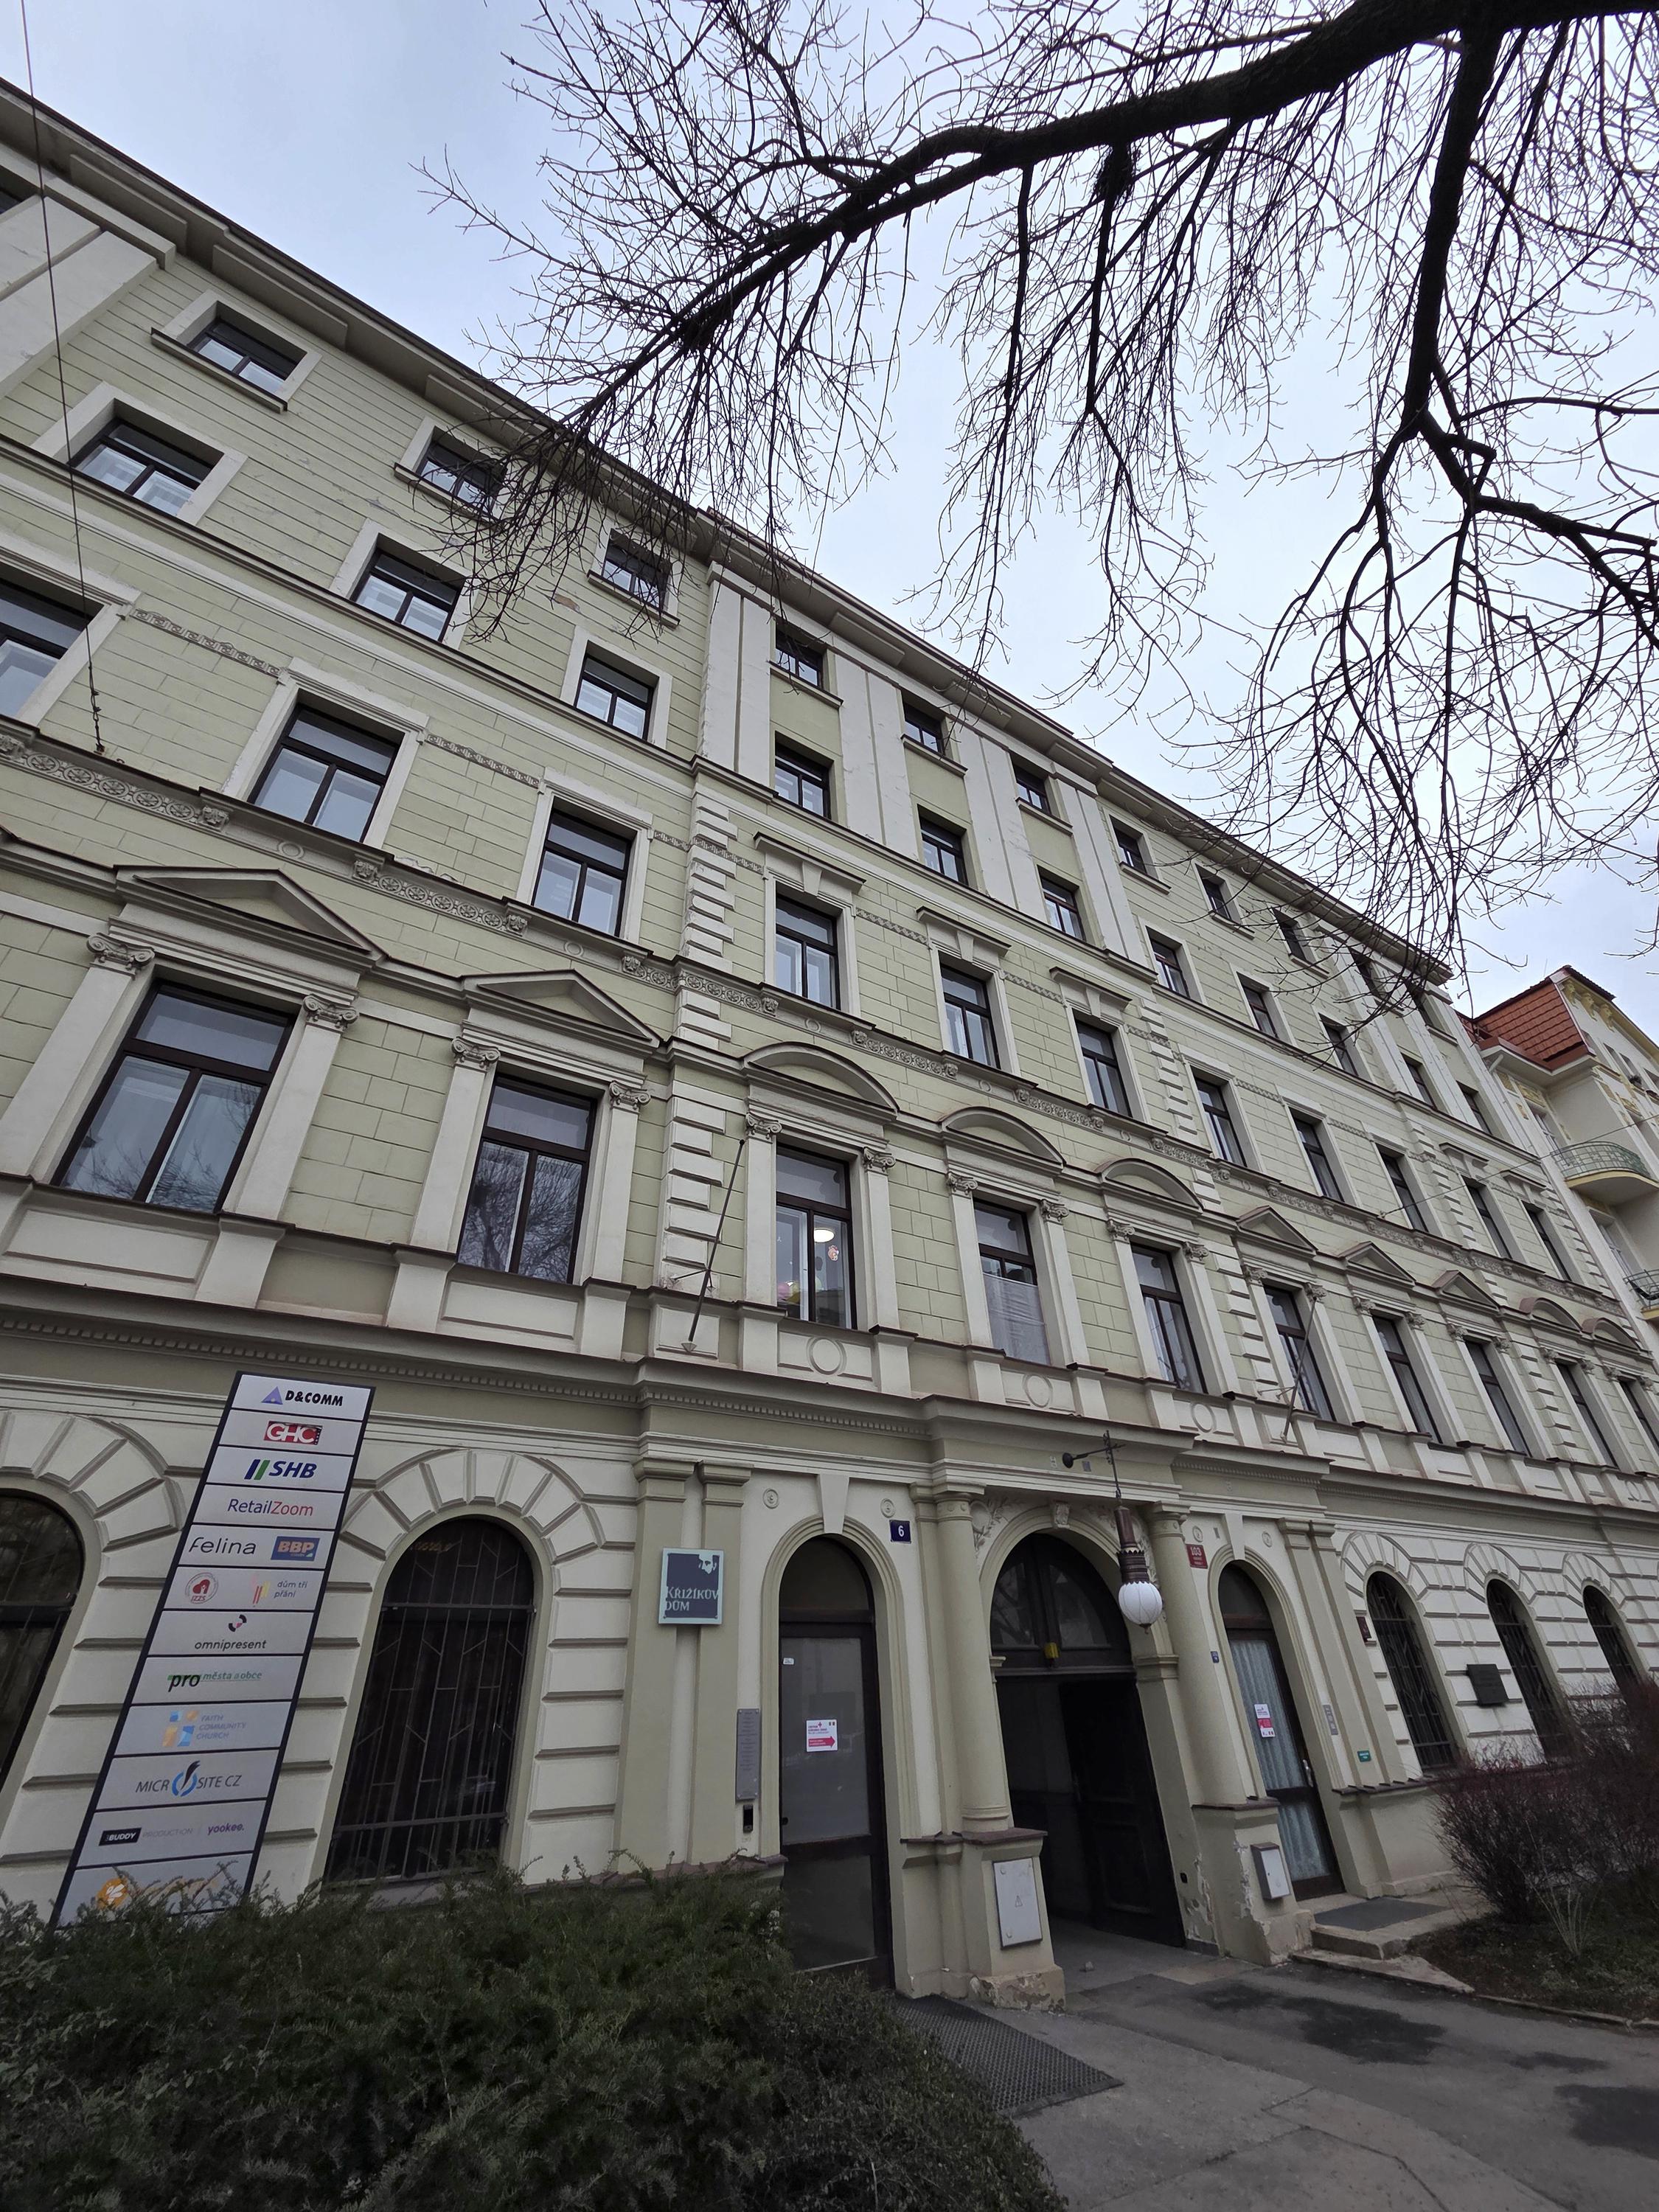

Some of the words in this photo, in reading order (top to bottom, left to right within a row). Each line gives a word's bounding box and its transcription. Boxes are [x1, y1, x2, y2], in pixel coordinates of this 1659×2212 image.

[285, 1390, 344, 1407] D&COMM
[266, 1423, 315, 1444] GHC
[268, 1461, 318, 1478] SHB
[227, 1498, 314, 1517] RetailZoom
[897, 1525, 905, 1537] 6
[277, 1540, 315, 1554] BBP
[277, 1580, 296, 1588] dům
[194, 1639, 268, 1652] omnipresent
[167, 1674, 201, 1693] pro
[202, 1671, 232, 1680] města
[240, 1671, 262, 1680] obce
[201, 1714, 223, 1722] FAITH
[224, 1774, 243, 1787] CZ
